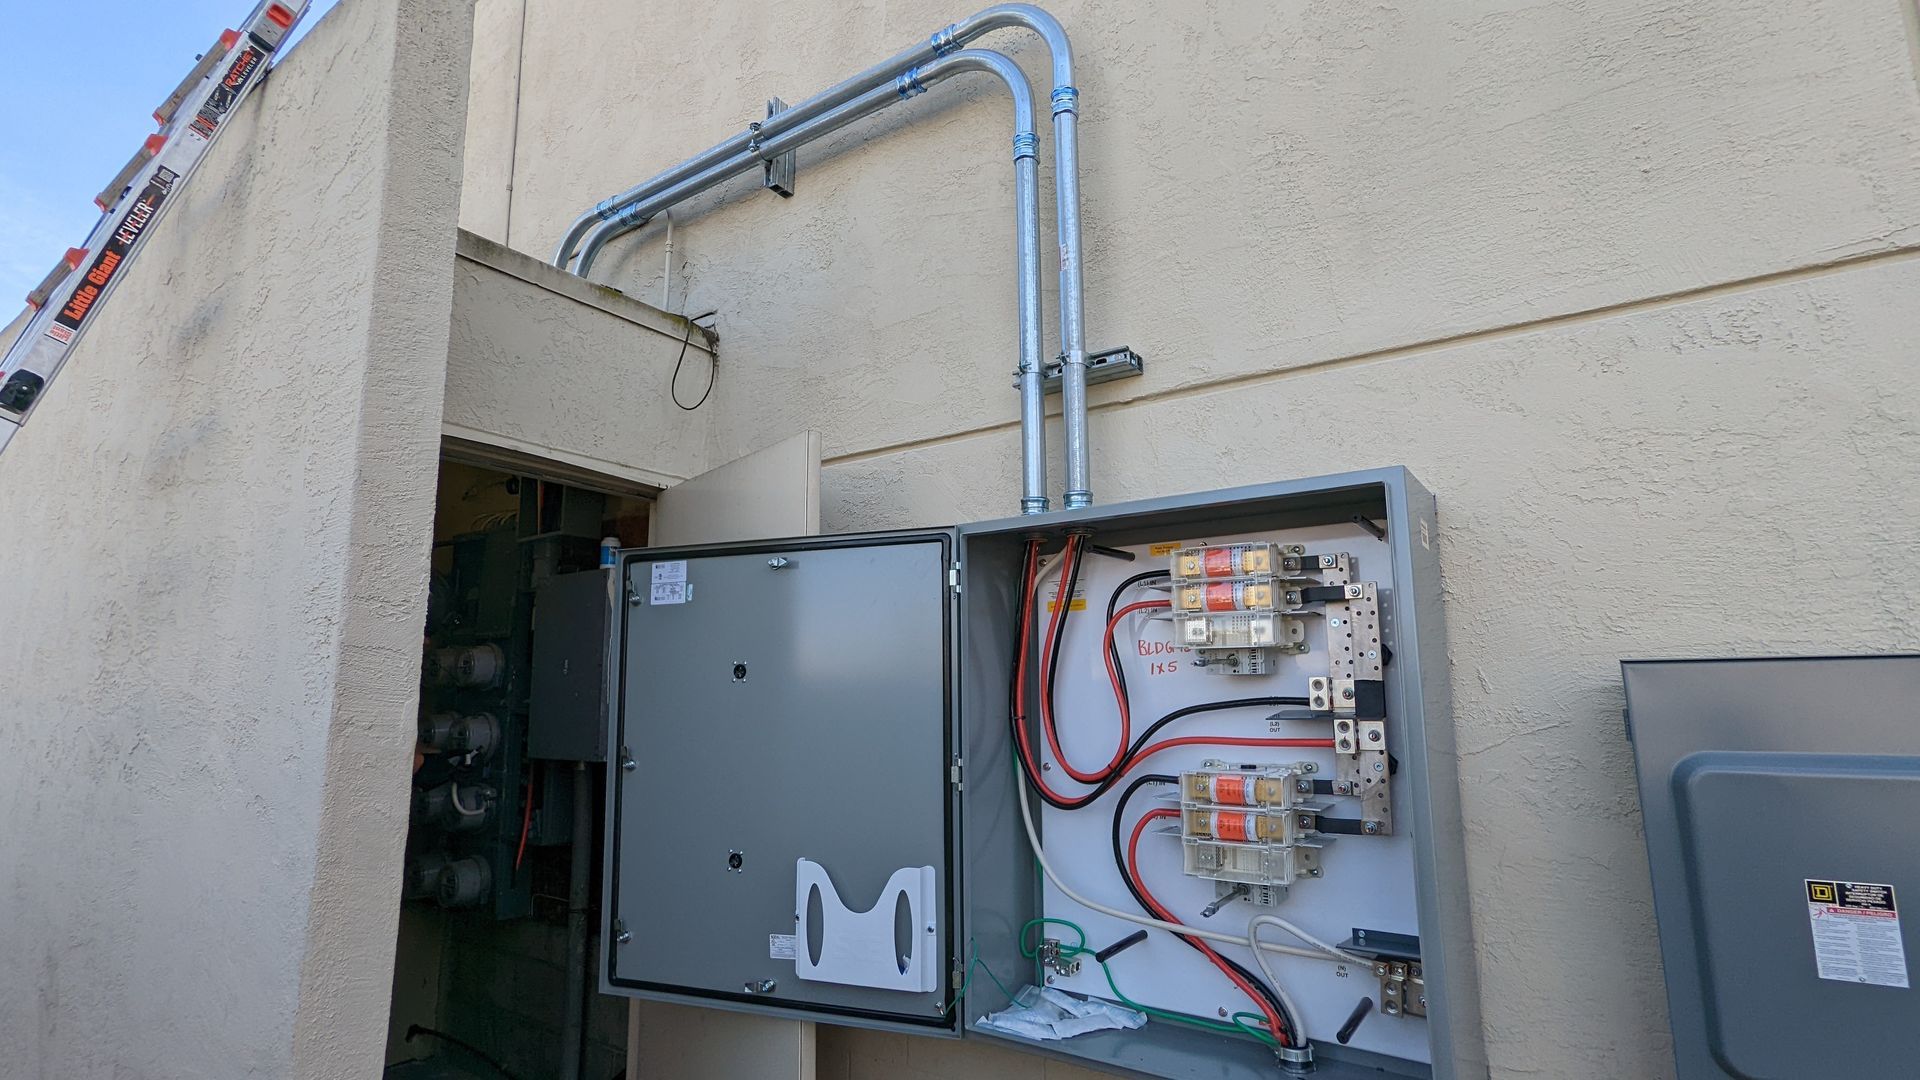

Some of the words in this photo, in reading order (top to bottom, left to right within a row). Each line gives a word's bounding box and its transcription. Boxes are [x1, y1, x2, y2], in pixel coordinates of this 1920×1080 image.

[63, 285, 98, 320] Little
[88, 249, 121, 285] Giant
[116, 200, 154, 244] LEVELER
[1138, 640, 1175, 656] BLDG
